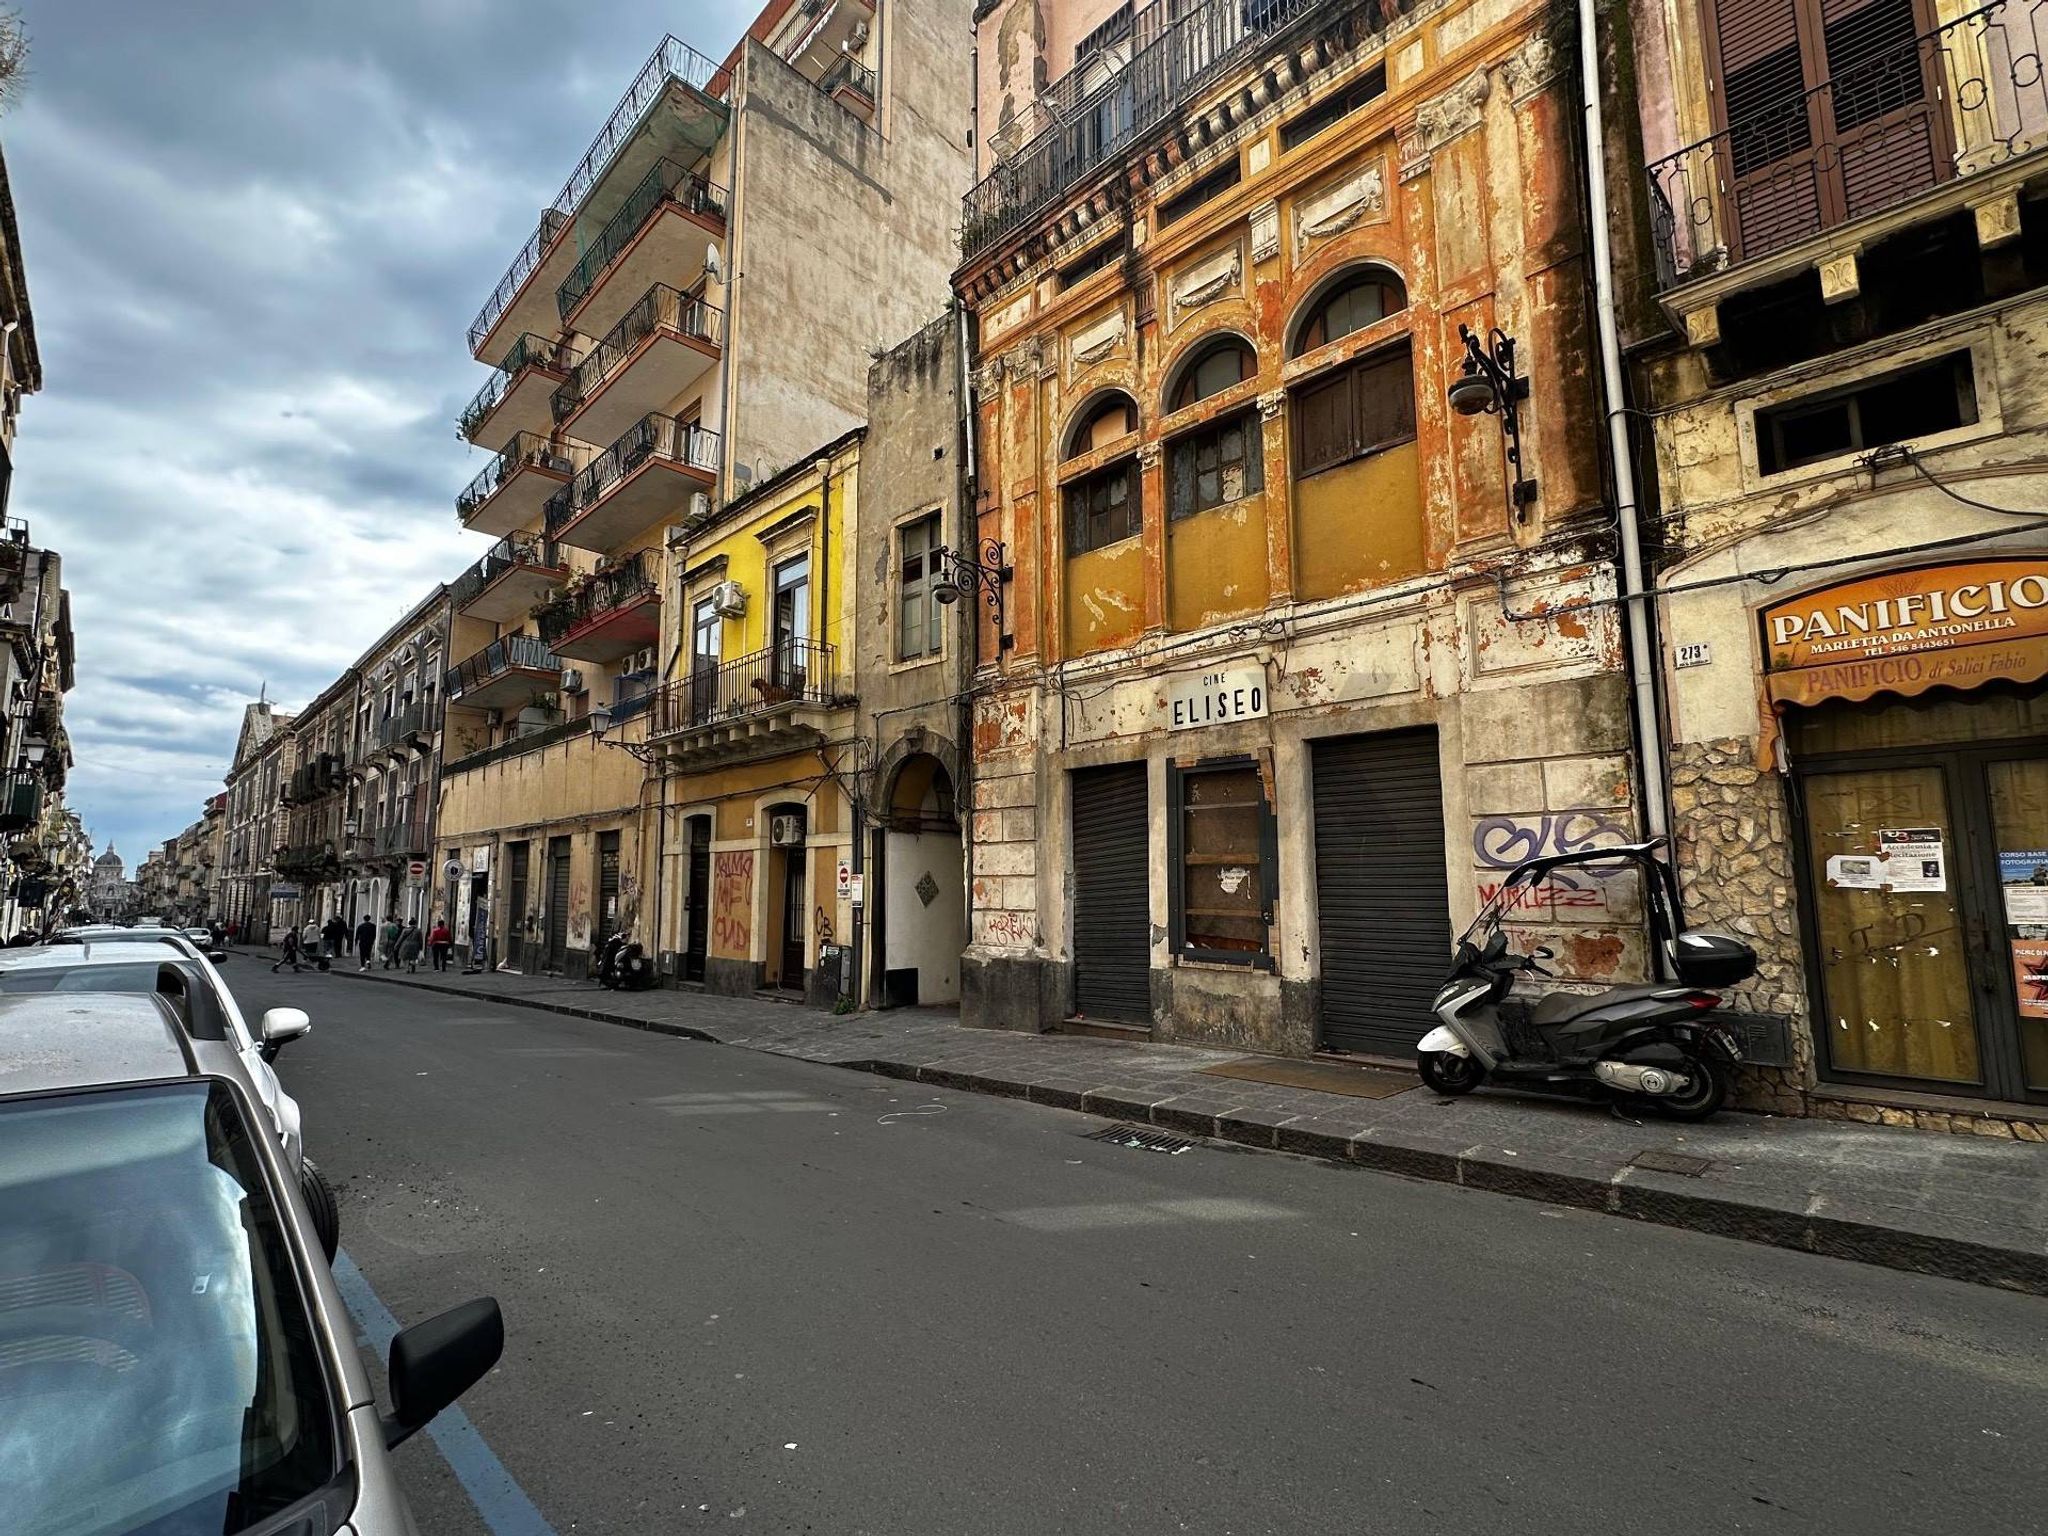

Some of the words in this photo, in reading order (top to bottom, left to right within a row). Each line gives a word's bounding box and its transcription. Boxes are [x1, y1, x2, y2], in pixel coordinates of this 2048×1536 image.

[1773, 575, 2048, 646] PANIFICIO
[1680, 645, 1701, 661] 273
[1811, 635, 1889, 655] MARLETTA
[1892, 631, 1914, 643] DA
[1917, 616, 2017, 640] ANTONELLA
[1890, 643, 1910, 653] 346
[1203, 672, 1226, 686] CINE
[1807, 656, 1921, 693] PANIFICIO
[1928, 660, 1943, 679] di
[1947, 656, 1984, 676] Salici
[1989, 651, 2026, 672] Fabio
[1174, 687, 1261, 725] ELISEO
